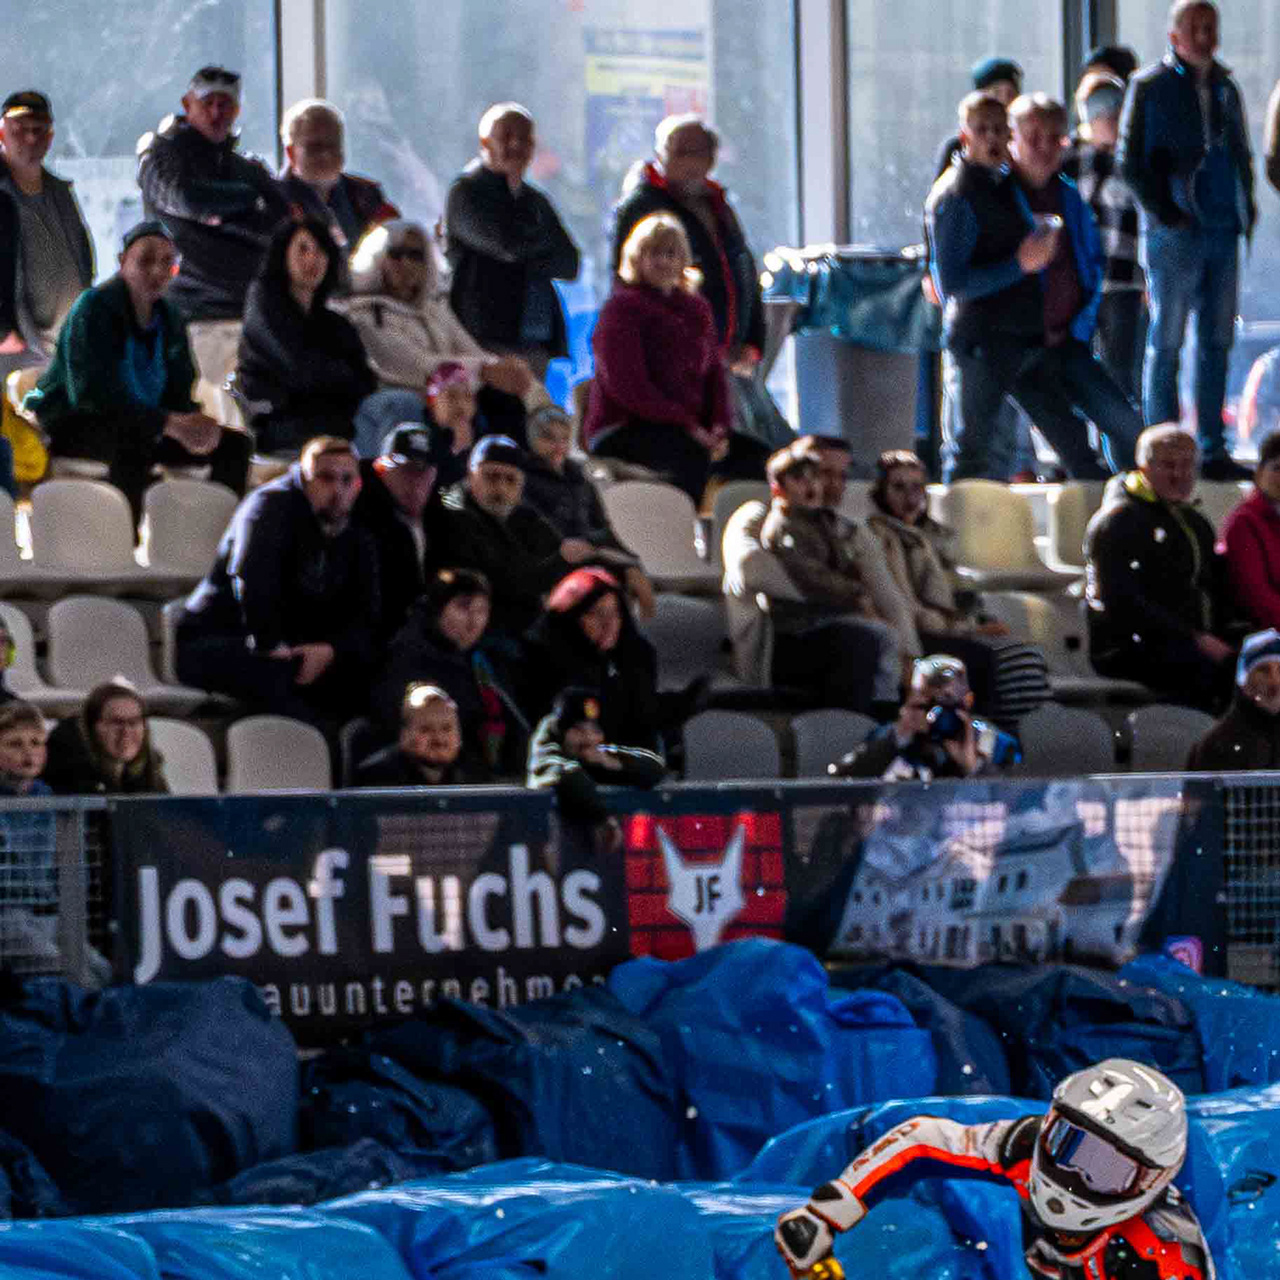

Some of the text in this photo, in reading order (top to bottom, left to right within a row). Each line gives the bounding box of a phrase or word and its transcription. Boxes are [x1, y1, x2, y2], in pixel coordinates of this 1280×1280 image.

[134, 843, 606, 987] Josef Fuchs
[694, 874, 721, 915] JF
